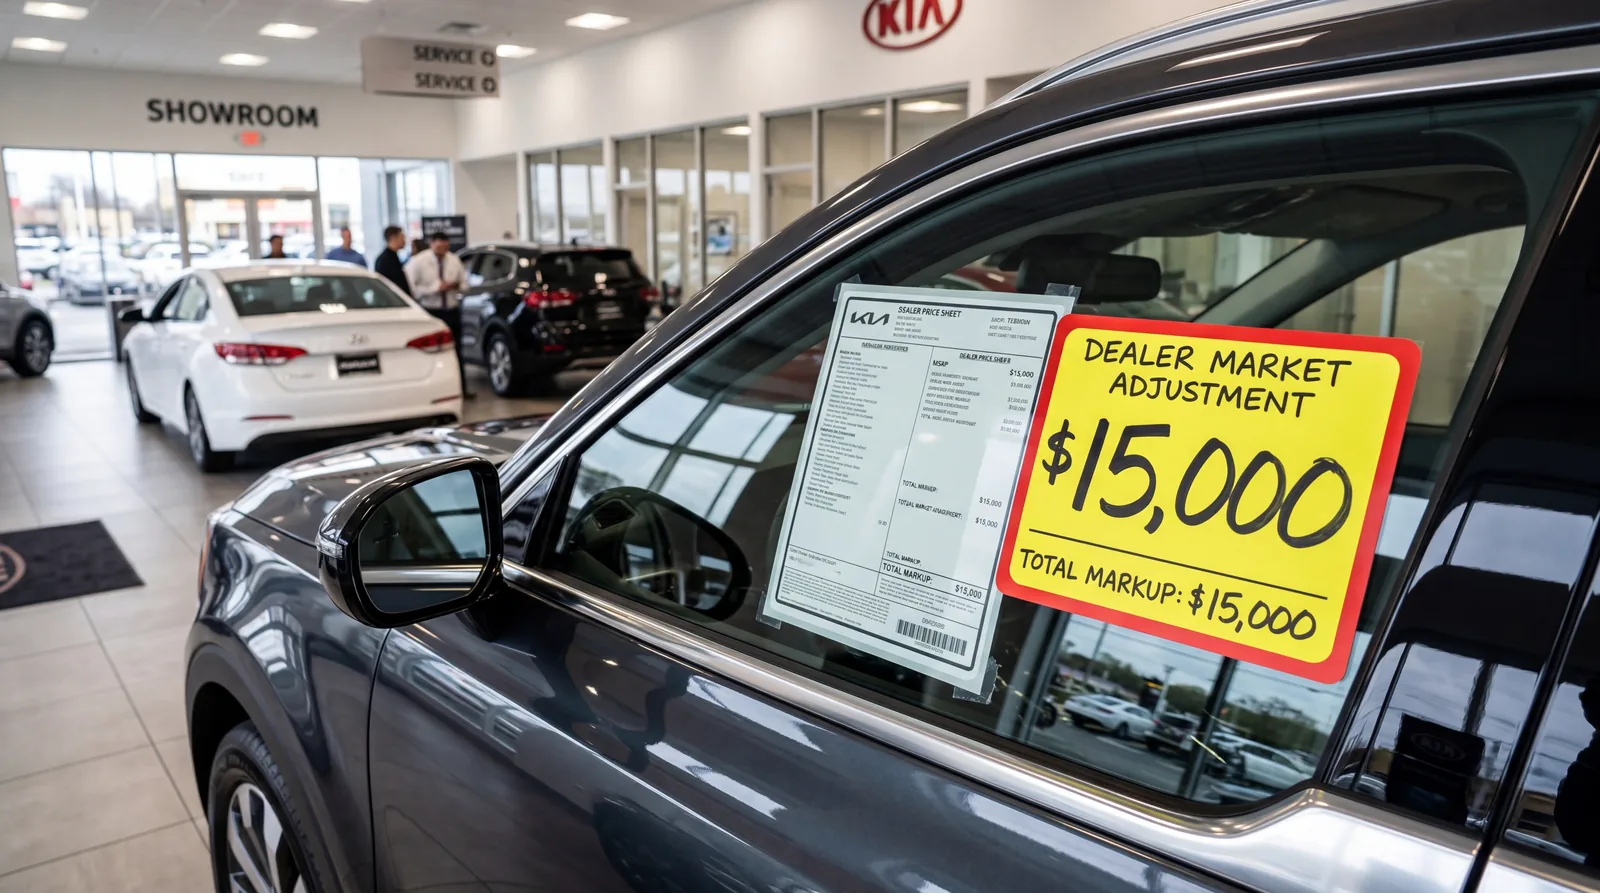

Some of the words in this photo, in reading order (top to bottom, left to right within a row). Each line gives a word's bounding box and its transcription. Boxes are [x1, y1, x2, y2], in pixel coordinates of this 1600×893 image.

[878, 0, 945, 38] KIA
[413, 44, 476, 65] SERVICE
[415, 72, 476, 91] SERVICE
[146, 97, 319, 129] SHOWROOM
[922, 308, 940, 316] PRICE
[940, 309, 962, 318] SHEET
[1084, 338, 1194, 371] DEALER
[1210, 350, 1352, 387] MARKET
[1009, 369, 1035, 378] $15,000
[1109, 372, 1316, 418] ADJUSTMENT
[902, 480, 917, 488] TOTAL
[1041, 417, 1353, 549] $15,000
[979, 497, 1002, 507] $15,000
[975, 517, 998, 528] $15,000
[886, 551, 901, 560] TOTAL
[883, 562, 902, 576] TOTAL
[903, 569, 933, 584] MARKUP:
[955, 585, 982, 599] $15,000
[1020, 549, 1078, 580] TOTAL
[1085, 566, 1182, 604] MARKUP:
[1188, 583, 1317, 641] $15,000
